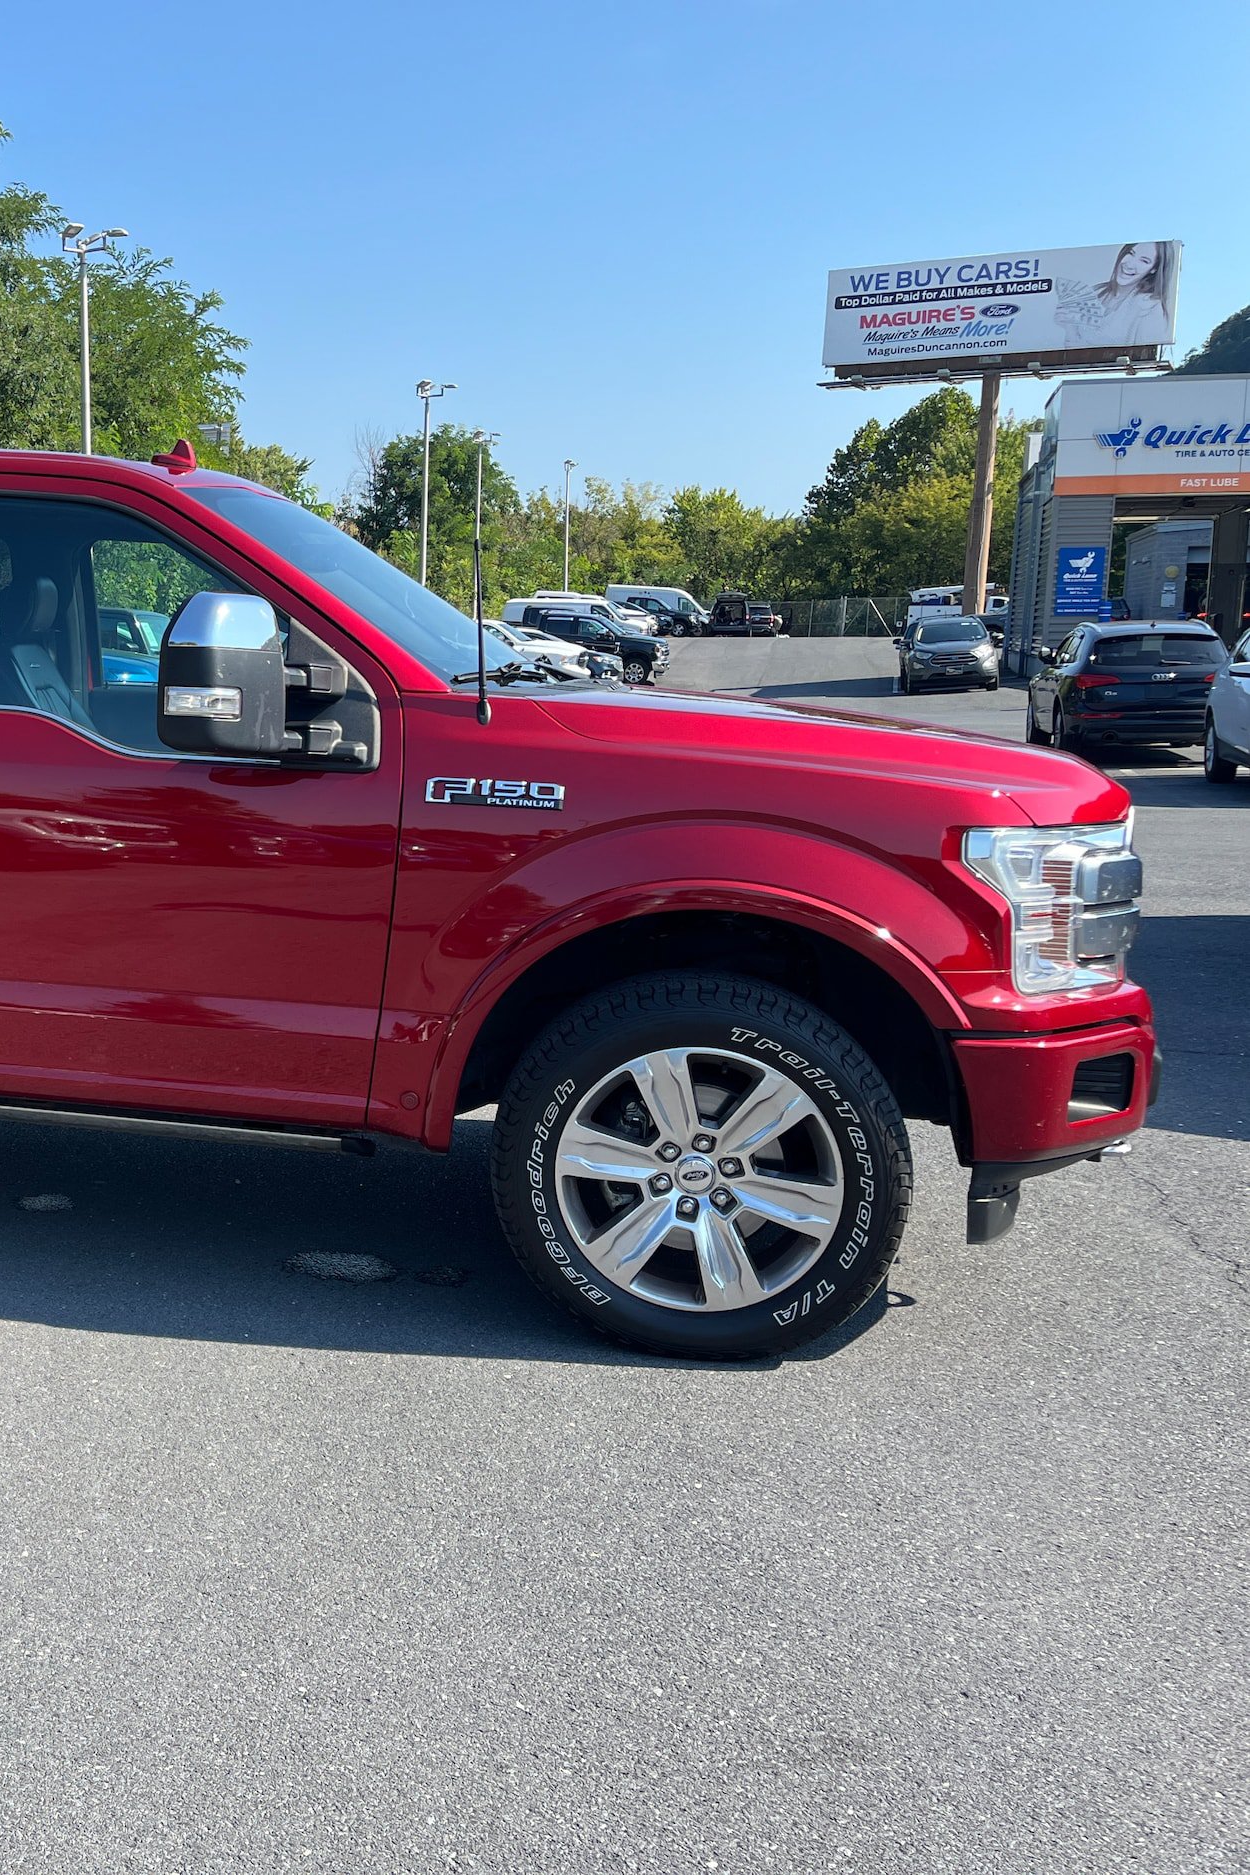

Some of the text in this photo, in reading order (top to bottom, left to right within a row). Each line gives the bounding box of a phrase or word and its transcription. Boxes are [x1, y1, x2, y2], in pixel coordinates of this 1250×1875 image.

[850, 259, 1039, 292] WE BUY CARS!
[840, 281, 1048, 307] Top Dollar Paid for All Makes & Models
[859, 305, 975, 329] MAGUIRE'S
[863, 318, 1015, 344] Maguire's Means More!
[867, 339, 1007, 356] MaguiresDuncannon.com
[1144, 423, 1234, 448] Quick
[1208, 449, 1235, 457] AUTO
[1180, 478, 1239, 487] FAST LUBE
[486, 796, 556, 809] PLATINUM
[731, 1027, 875, 1326] Trail-Terrain T/A
[527, 1079, 612, 1306] BFGoodrich
